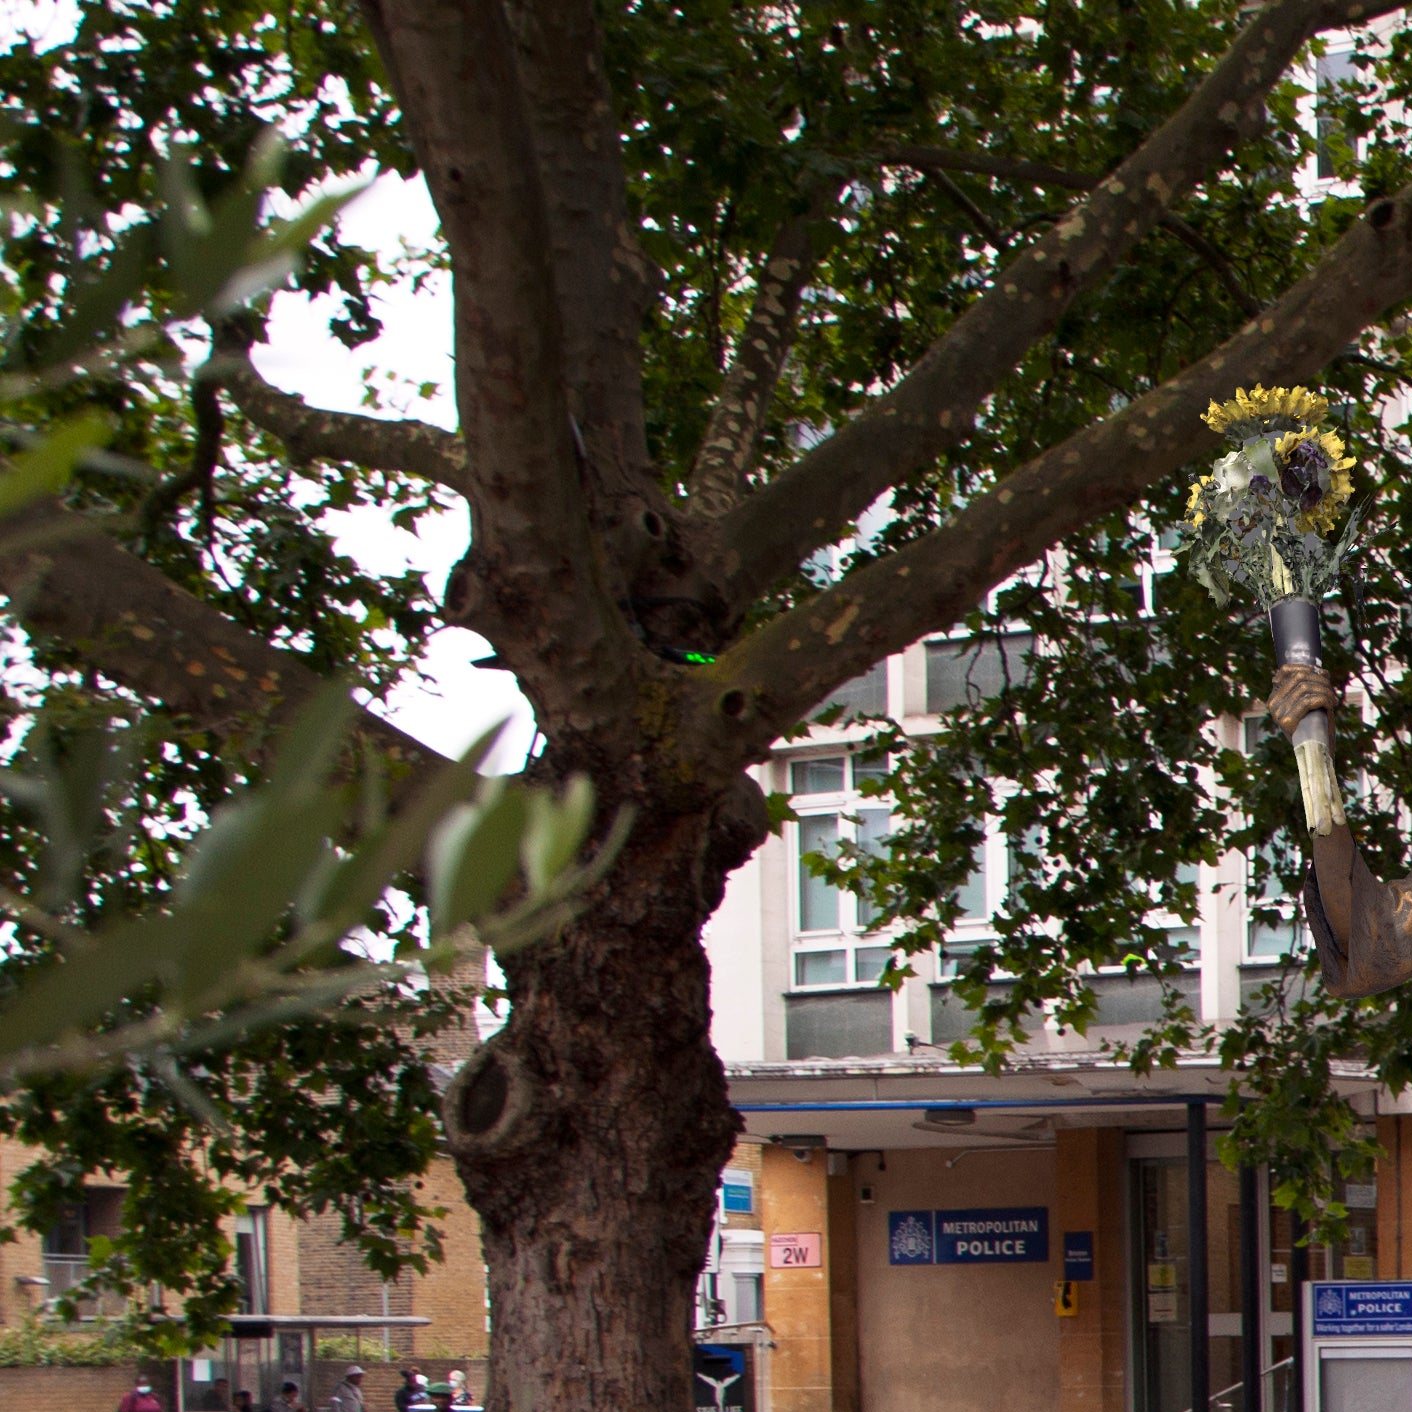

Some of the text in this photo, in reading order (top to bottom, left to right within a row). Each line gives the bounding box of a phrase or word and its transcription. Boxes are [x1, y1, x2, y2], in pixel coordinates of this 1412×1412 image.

[942, 1220, 1039, 1235] METROPOLITAN
[956, 1240, 1026, 1256] POLICE
[783, 1247, 809, 1265] 2W
[1349, 1291, 1410, 1300] METROPOLITAN
[1358, 1303, 1402, 1313] POLICE
[1316, 1323, 1340, 1333] Working
